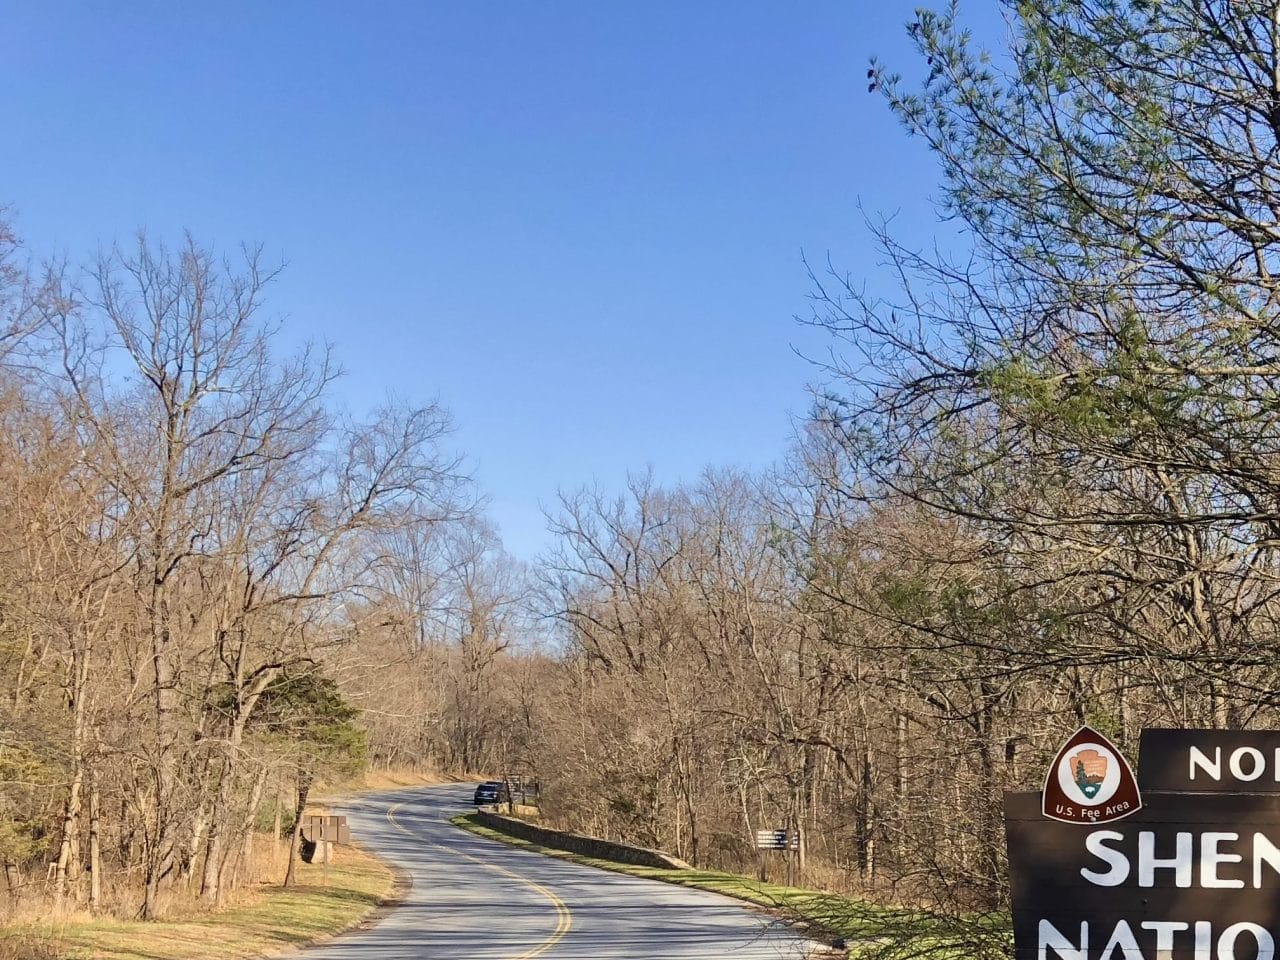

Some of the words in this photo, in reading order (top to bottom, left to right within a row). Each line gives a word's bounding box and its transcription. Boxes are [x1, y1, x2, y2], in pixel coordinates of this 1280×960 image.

[1056, 804, 1076, 817] U.S.
[1081, 808, 1101, 818] Fee
[1105, 801, 1130, 816] Area
